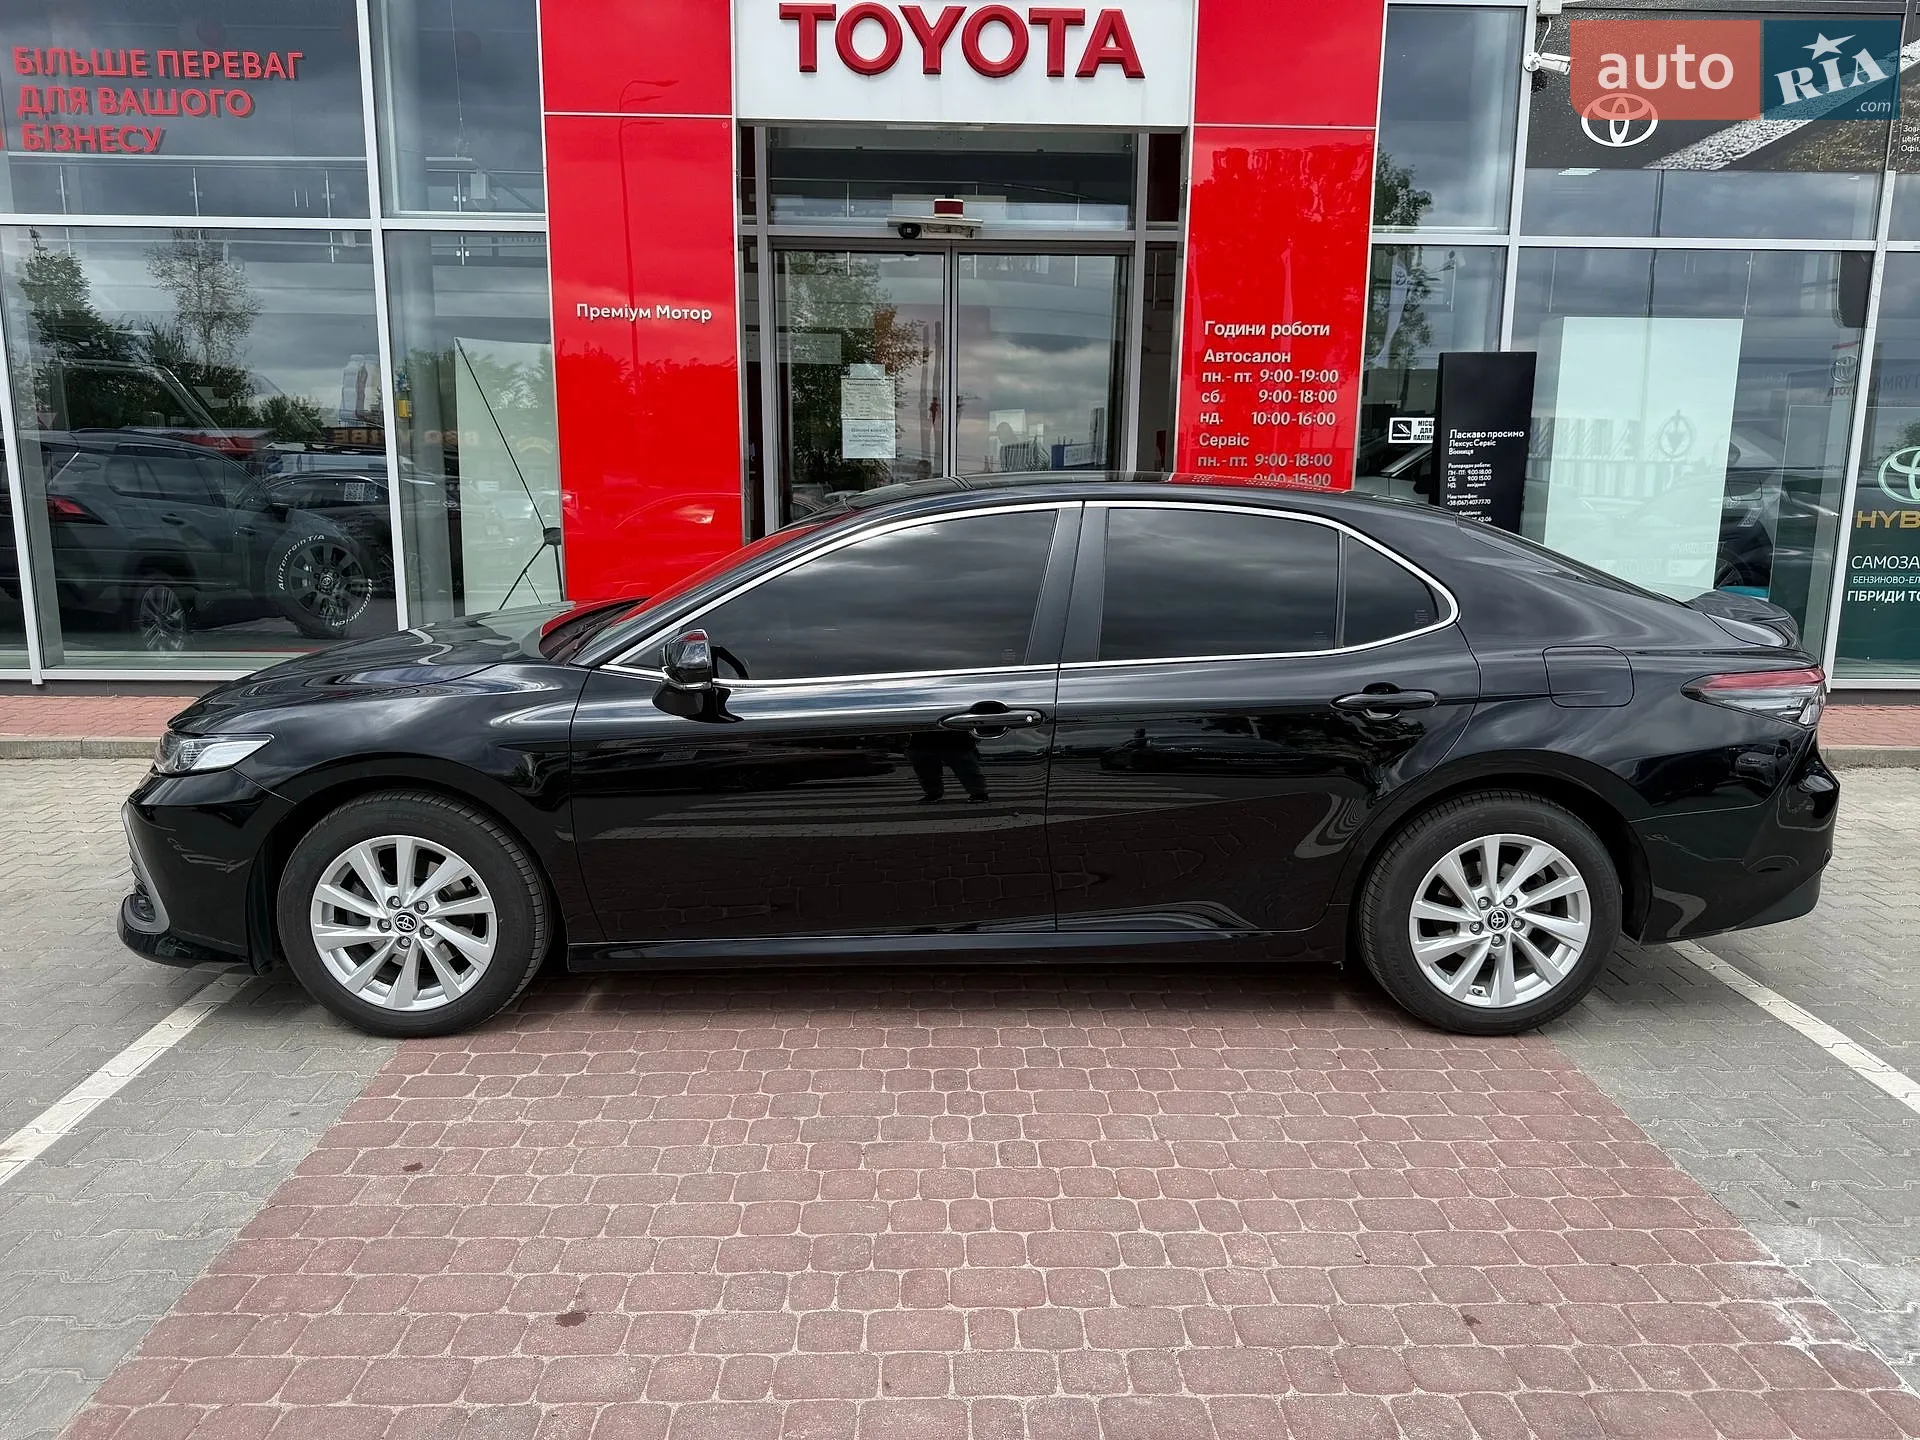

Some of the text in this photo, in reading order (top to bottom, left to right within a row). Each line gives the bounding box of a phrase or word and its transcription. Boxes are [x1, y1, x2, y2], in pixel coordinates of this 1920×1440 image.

[778, 2, 1145, 79] TOYOTA
[12, 47, 304, 80] БІЛЬШЕ ПЕРЕВАГ
[17, 85, 253, 120] ДЛЯ ВАШОГО
[22, 124, 162, 152] БІЗНЕСУ
[576, 303, 713, 323] Преміум Мотор
[1204, 320, 1330, 339] Години роботи
[1203, 348, 1291, 363] Автосалон
[1259, 369, 1339, 383] 9:00-19:00
[1201, 389, 1337, 403] сб. 9:00-18:00
[1200, 411, 1336, 425] нд. 10:00-16:00
[1199, 432, 1250, 448] Сервіс
[1487, 431, 1525, 439] просимо
[1254, 453, 1333, 467] 9:00-18:00
[1847, 590, 1905, 603] ГІБРИДИ
